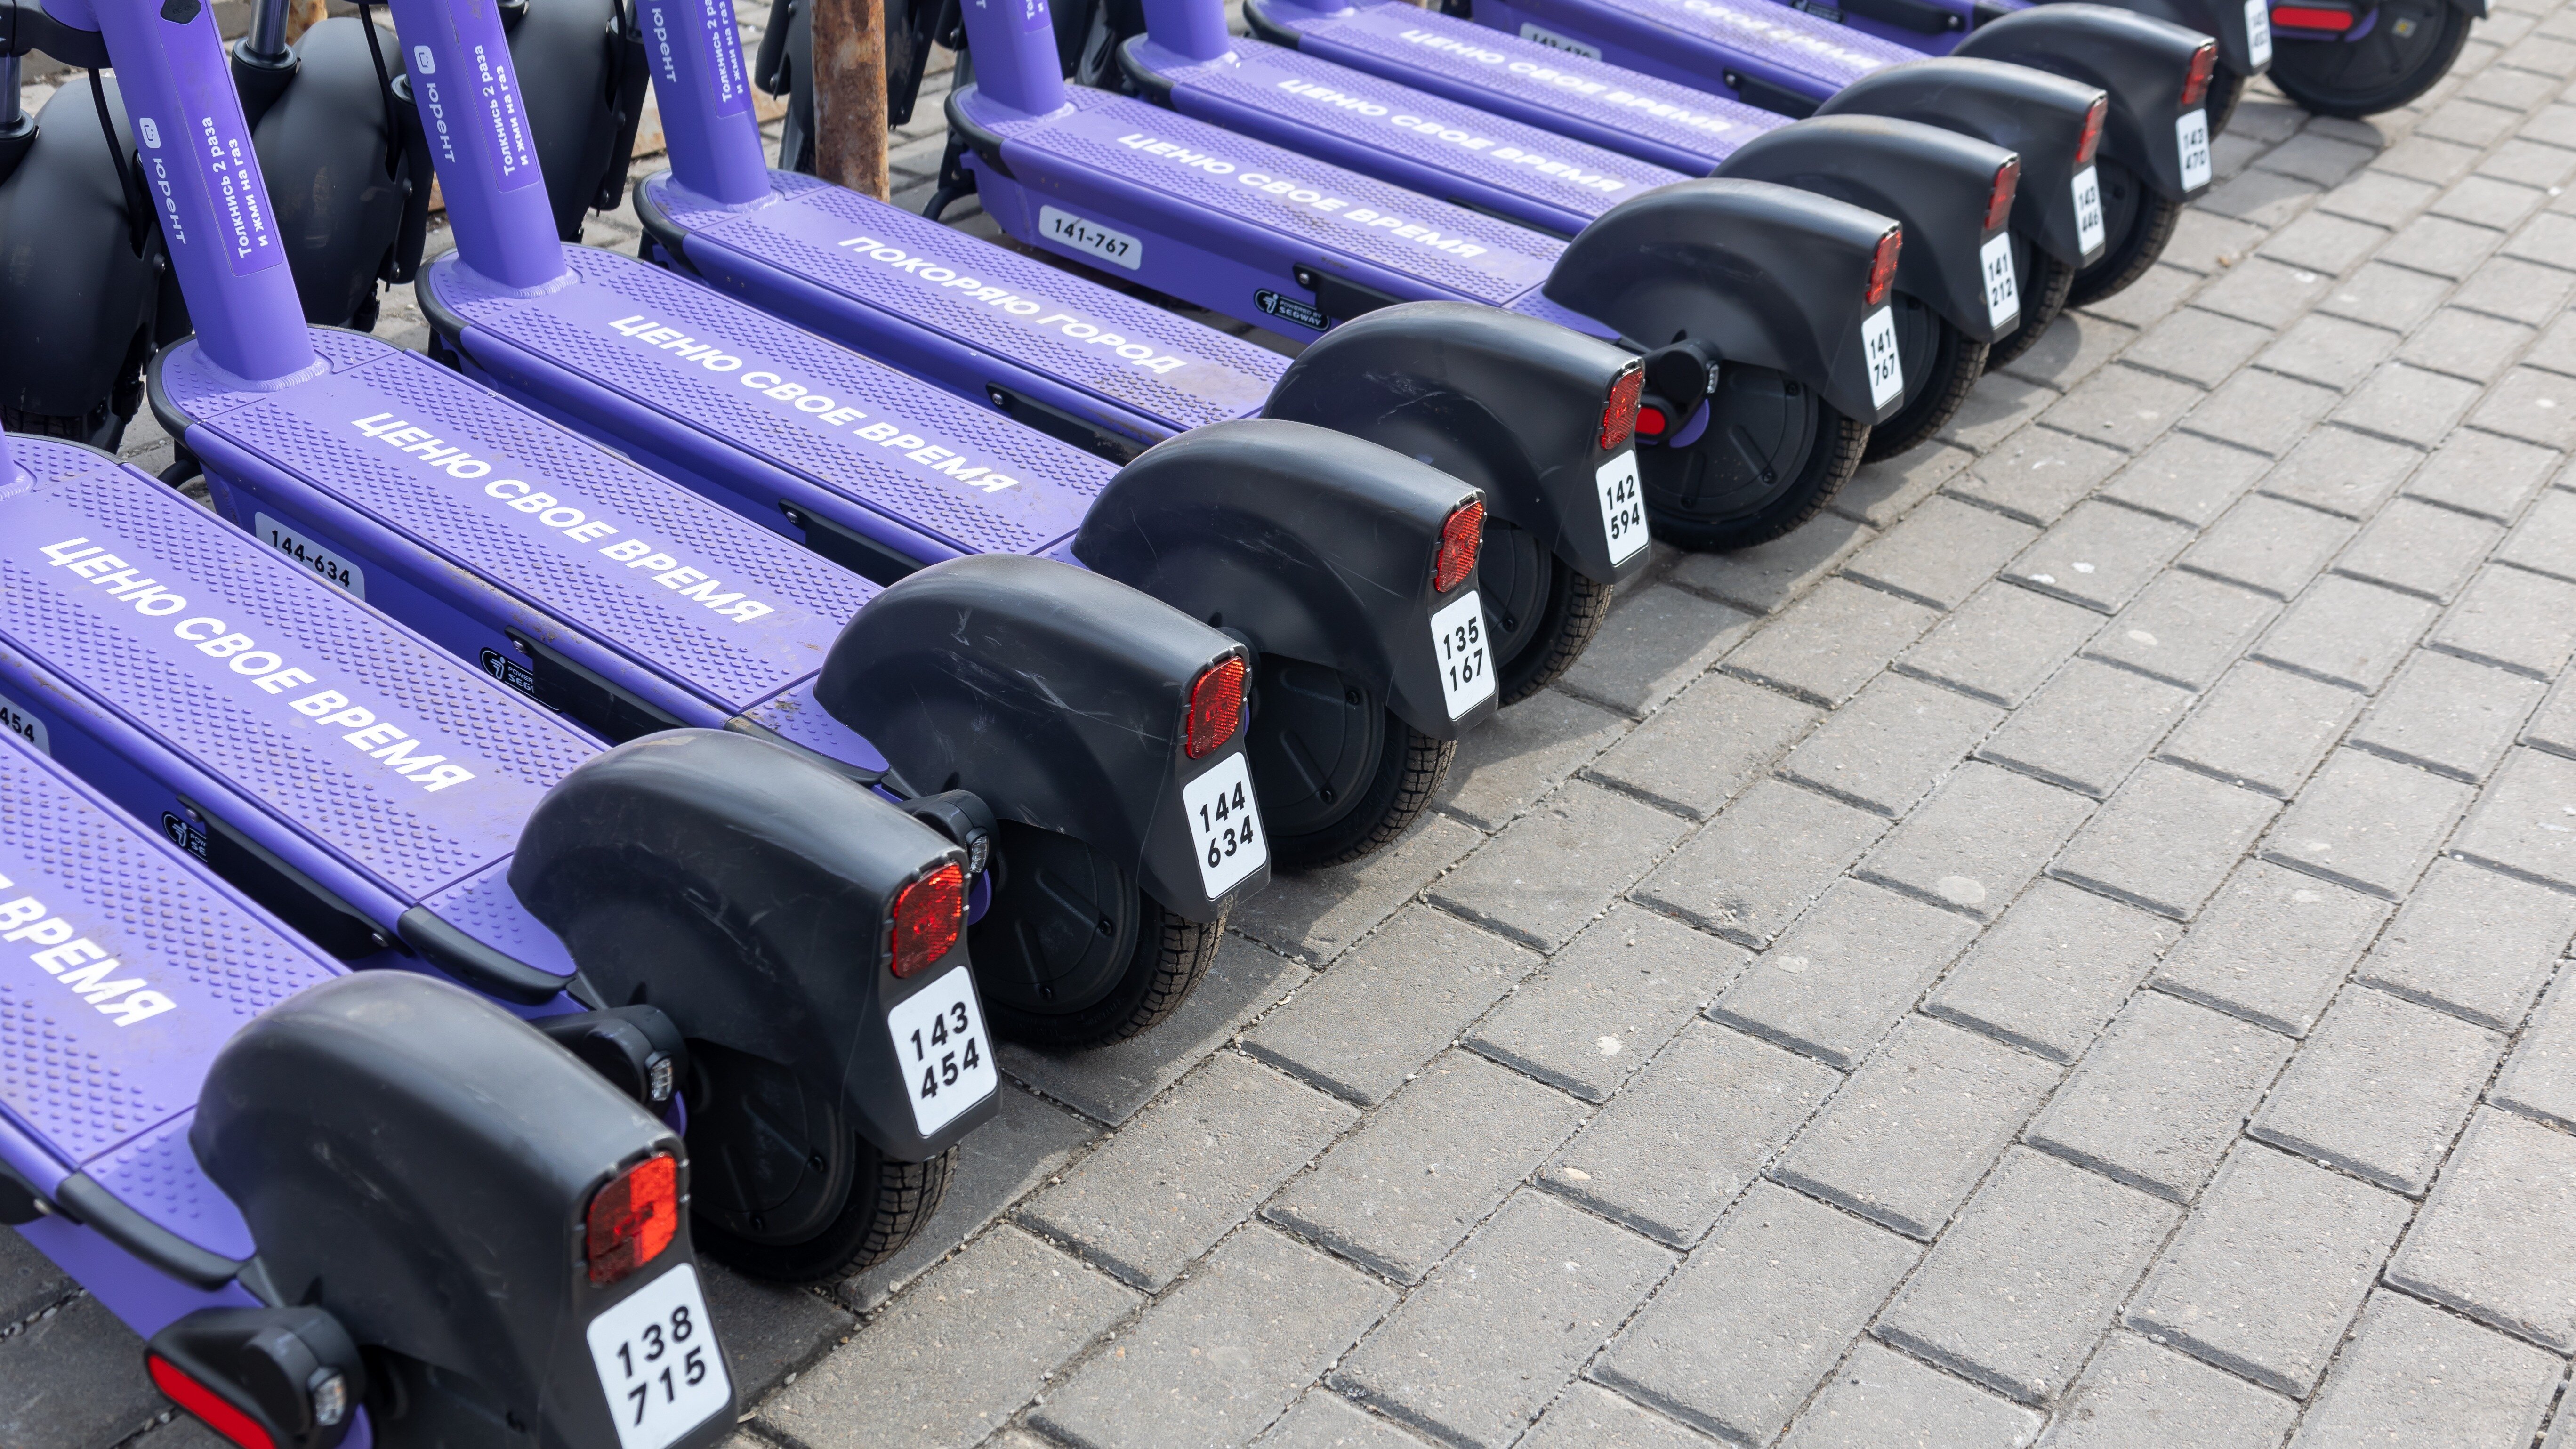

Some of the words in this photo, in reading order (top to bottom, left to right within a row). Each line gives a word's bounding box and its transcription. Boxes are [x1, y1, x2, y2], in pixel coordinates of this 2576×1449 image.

[704, 0, 716, 16] ра
[707, 19, 717, 29] 2
[719, 1, 729, 25] газ
[652, 8, 676, 83] юрент
[724, 27, 733, 46] на
[475, 45, 493, 83] раза
[496, 65, 514, 91] газ
[712, 31, 732, 103] Толкнись
[729, 48, 741, 81] жми
[1399, 30, 1505, 64] ЦЕНЮ
[1508, 62, 1608, 95] СВОЕ
[1604, 93, 1734, 133] ВРЕМЯ
[483, 85, 495, 97] 2
[504, 93, 515, 114] на
[736, 84, 743, 94] и
[202, 117, 225, 157] раза
[426, 83, 456, 163] юрент
[490, 99, 515, 176] Толкнись
[510, 116, 525, 153] жми
[1277, 79, 1388, 117] ЦЕНЮ
[1391, 114, 1496, 151] СВОЕ
[1489, 146, 1626, 193] ВРЕМЯ
[2184, 127, 2204, 150] 143
[212, 161, 227, 173] 2
[228, 138, 247, 166] газ
[520, 154, 529, 166] и
[238, 169, 251, 191] на
[1117, 133, 1236, 174] ЦЕНЮ
[1238, 172, 1350, 213] СВОЕ
[1343, 209, 1489, 259] ВРЕМЯ
[2079, 185, 2095, 211] 143
[153, 158, 186, 244] юрент
[221, 175, 252, 258] Толкнись
[245, 194, 264, 232] жми
[258, 234, 269, 247] и
[1055, 218, 1130, 257] 141-767
[1988, 252, 2009, 281] 141
[838, 236, 1041, 320] ПОКОРЯЮ
[1034, 311, 1188, 375] ГОРОД
[1280, 300, 1312, 315] POWERED
[1991, 277, 2014, 306] 212
[1279, 306, 1322, 325] SEGWAY
[1870, 328, 1892, 361] 141
[1874, 354, 1896, 386] 767
[608, 314, 742, 371] ЦЕНЮ
[740, 371, 868, 427] СВОЕ
[852, 421, 1020, 493] ВРЕМЯ
[1606, 475, 1635, 511] 142
[350, 412, 491, 479] ЦЕНЮ
[484, 479, 620, 543] СВОЕ
[597, 539, 775, 623] ВРЕМЯ
[1611, 502, 1640, 540] 594
[271, 530, 351, 588] 144-634
[1443, 616, 1479, 660] 135
[39, 537, 187, 616] ЦЕНЮ
[173, 617, 318, 695] СВОЕ
[287, 689, 477, 792] ВРЕМЯ
[508, 666, 533, 684] POWER
[1449, 647, 1483, 692] 167
[1199, 781, 1246, 834] 144
[1208, 815, 1254, 869] 634
[0, 895, 177, 1027] ВРЕМЯ
[910, 1001, 968, 1061] 143
[920, 1037, 980, 1099] 454
[617, 1306, 693, 1378] 138
[628, 1346, 707, 1426] 715
